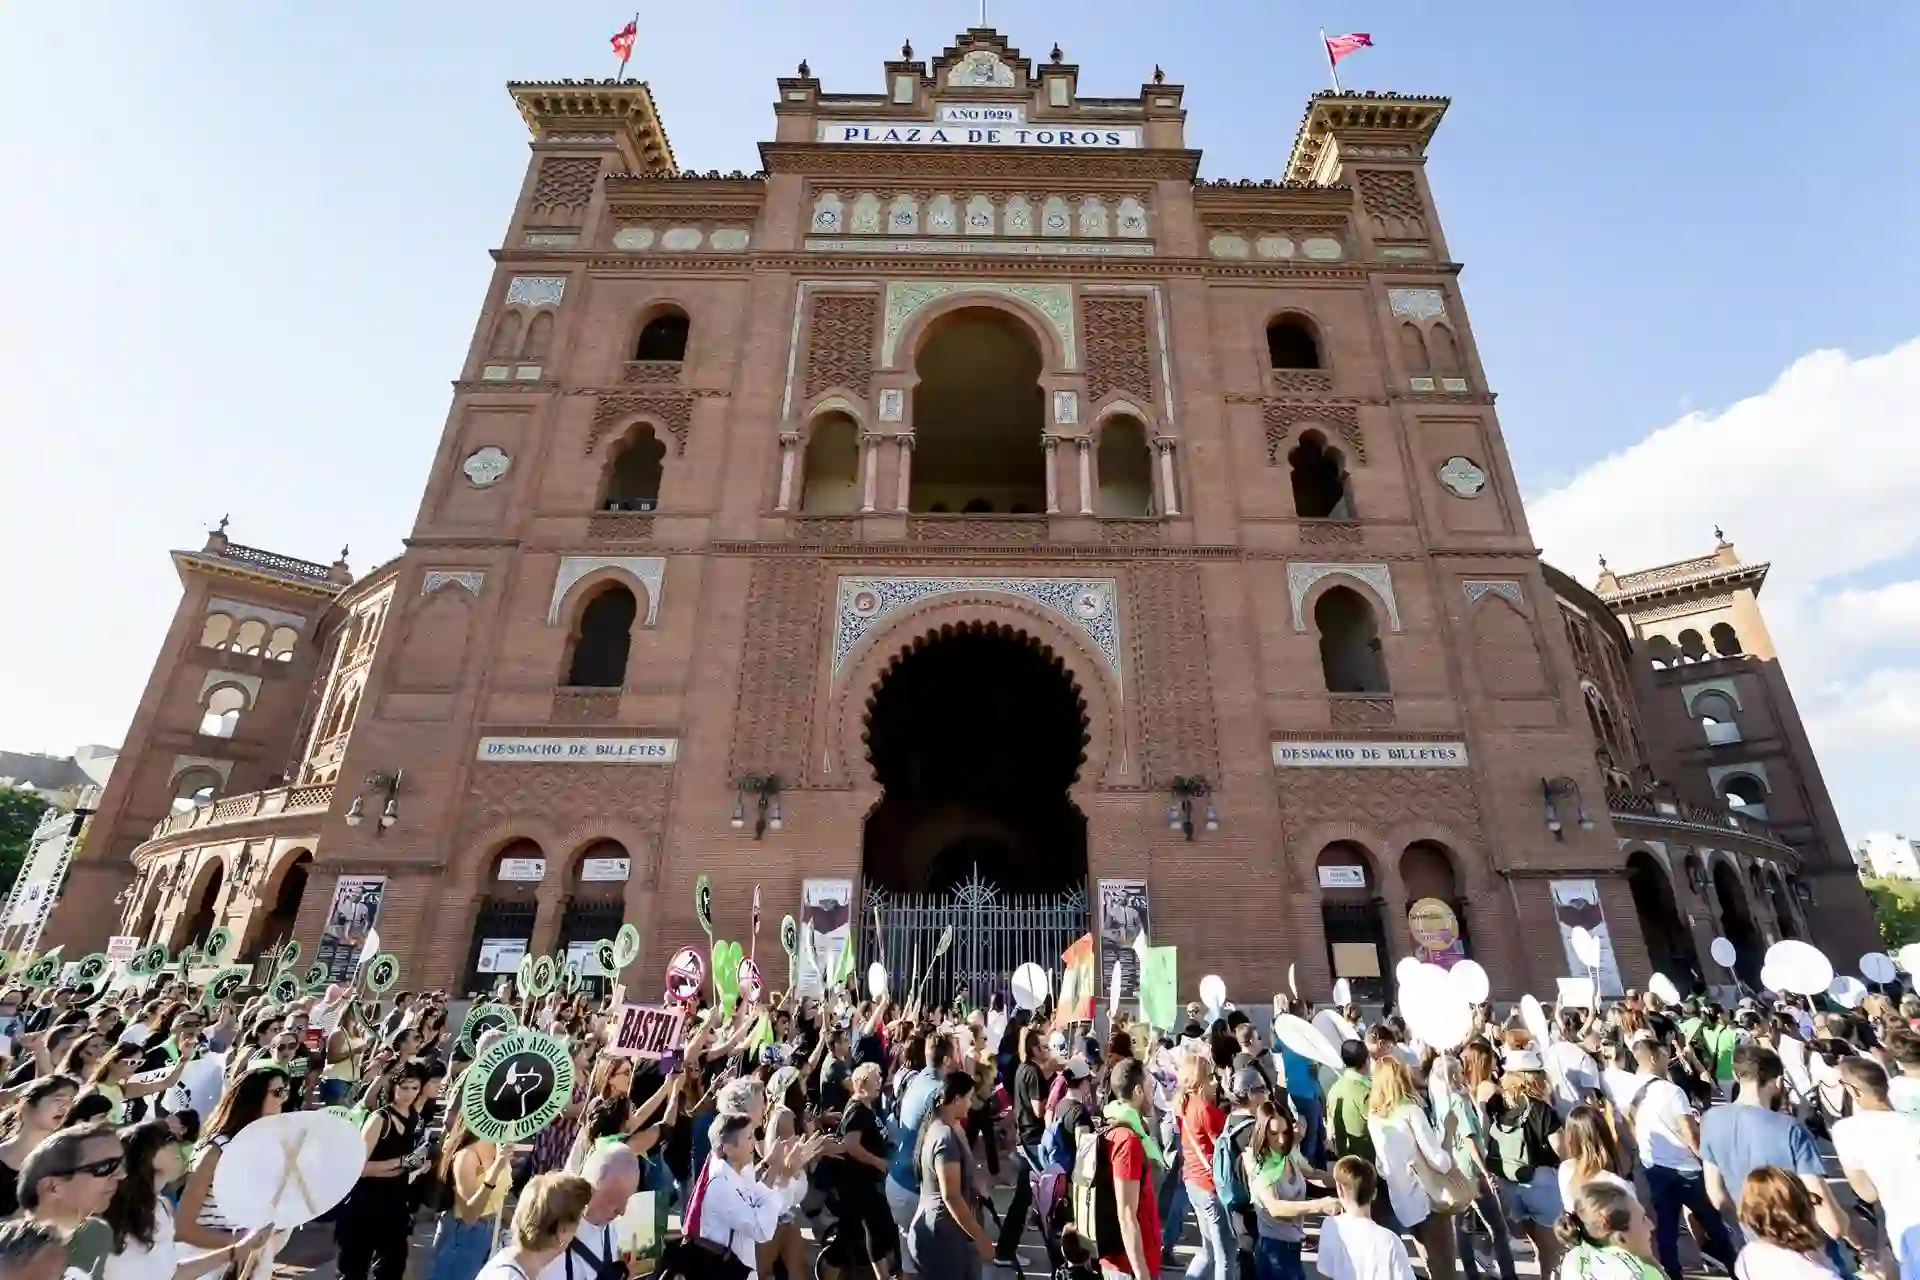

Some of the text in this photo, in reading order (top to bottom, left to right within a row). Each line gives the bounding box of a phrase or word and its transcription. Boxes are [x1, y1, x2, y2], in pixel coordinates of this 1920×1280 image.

[948, 108, 1012, 120] AÑO 1929
[844, 127, 1121, 145] PLAZA DE TOROS
[487, 743, 666, 756] DESPACHO DE BILLETES
[1281, 748, 1457, 760] DESPACHO DE BILLETES
[617, 1008, 678, 1053] BASTA!
